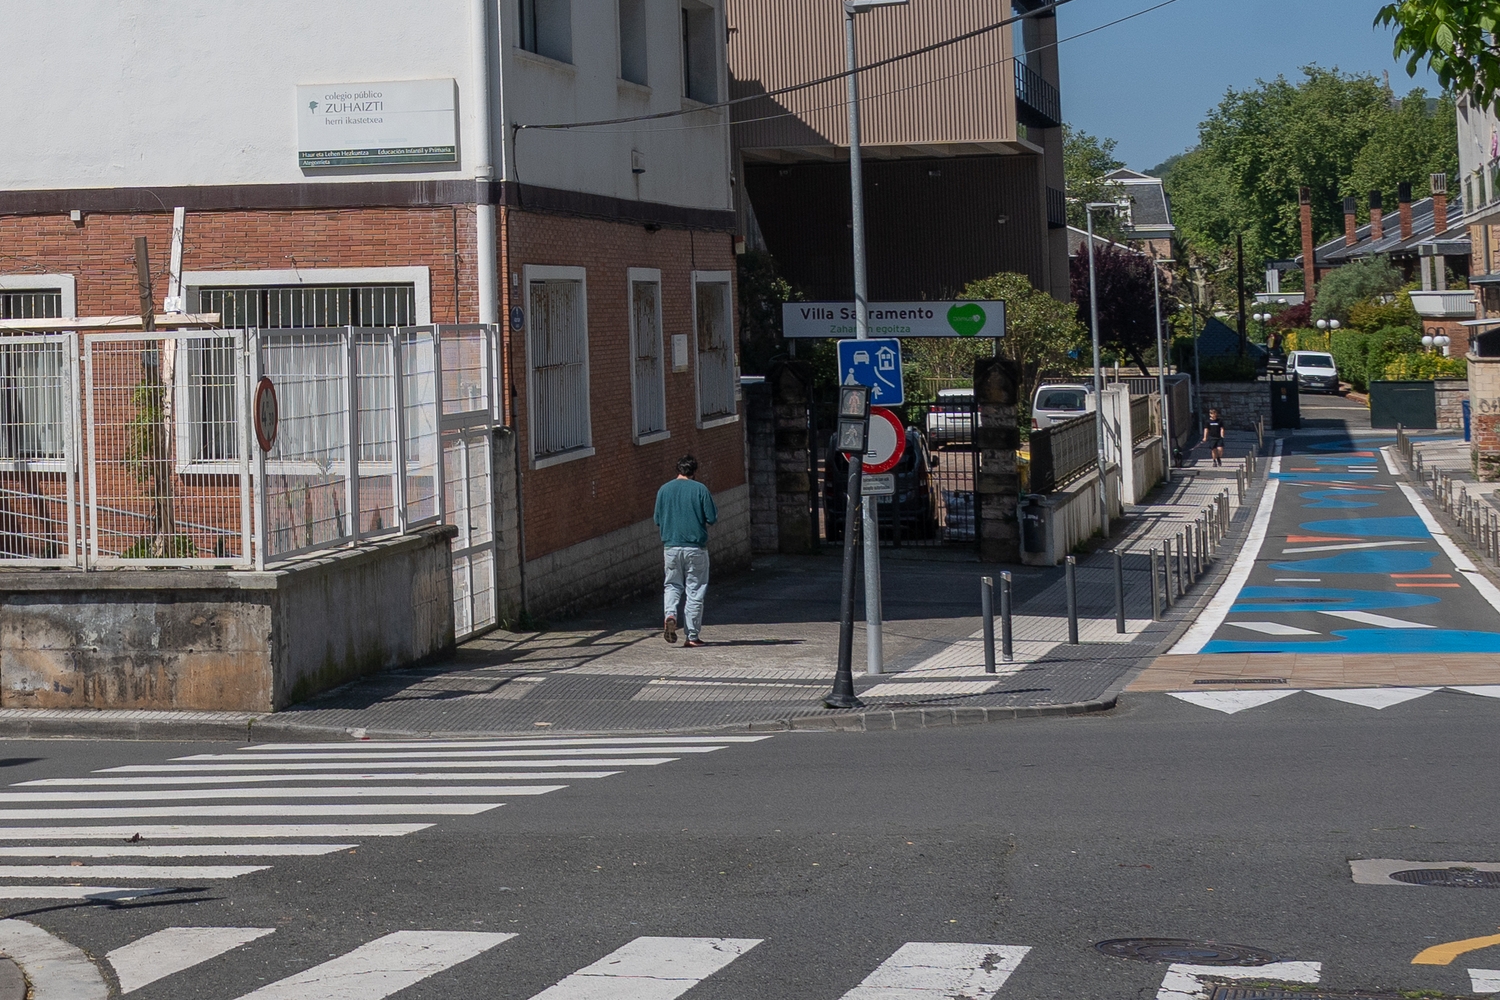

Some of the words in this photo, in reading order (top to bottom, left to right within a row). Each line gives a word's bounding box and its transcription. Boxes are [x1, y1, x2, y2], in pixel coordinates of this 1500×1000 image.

[325, 91, 352, 102] colegio
[354, 90, 383, 101] público
[325, 101, 383, 113] ZUHAIZTI
[325, 116, 343, 125] herri
[345, 116, 383, 124] ikastetxea
[800, 307, 834, 320] Villa
[840, 307, 934, 320] Saramento
[830, 325, 873, 334] Zaharn
[876, 325, 911, 335] egoitza
